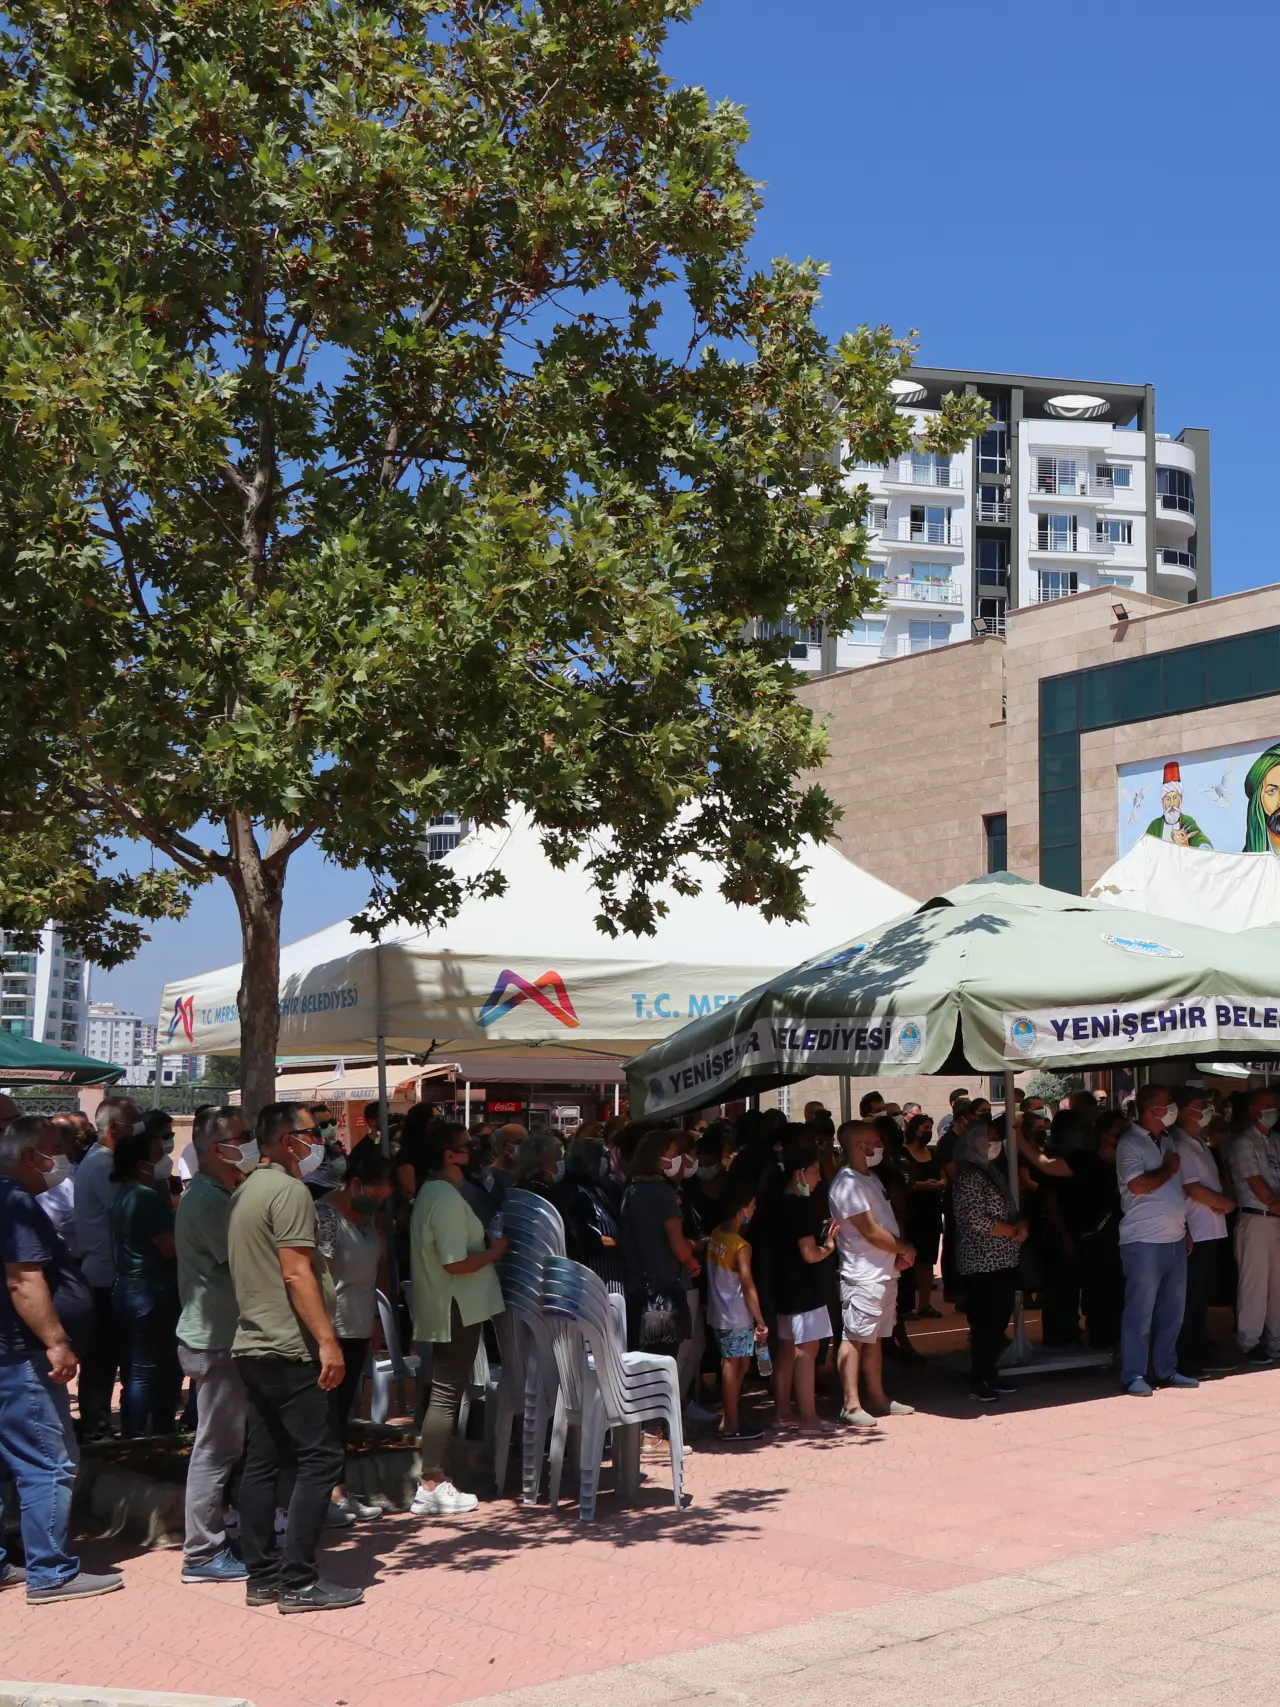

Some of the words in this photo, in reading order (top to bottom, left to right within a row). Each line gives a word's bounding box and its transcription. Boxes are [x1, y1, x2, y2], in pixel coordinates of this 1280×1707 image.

[301, 982, 358, 1014] BELEDİYESİ
[631, 993, 680, 1019] T.C.
[1050, 1002, 1207, 1042] YENİŞEHİR
